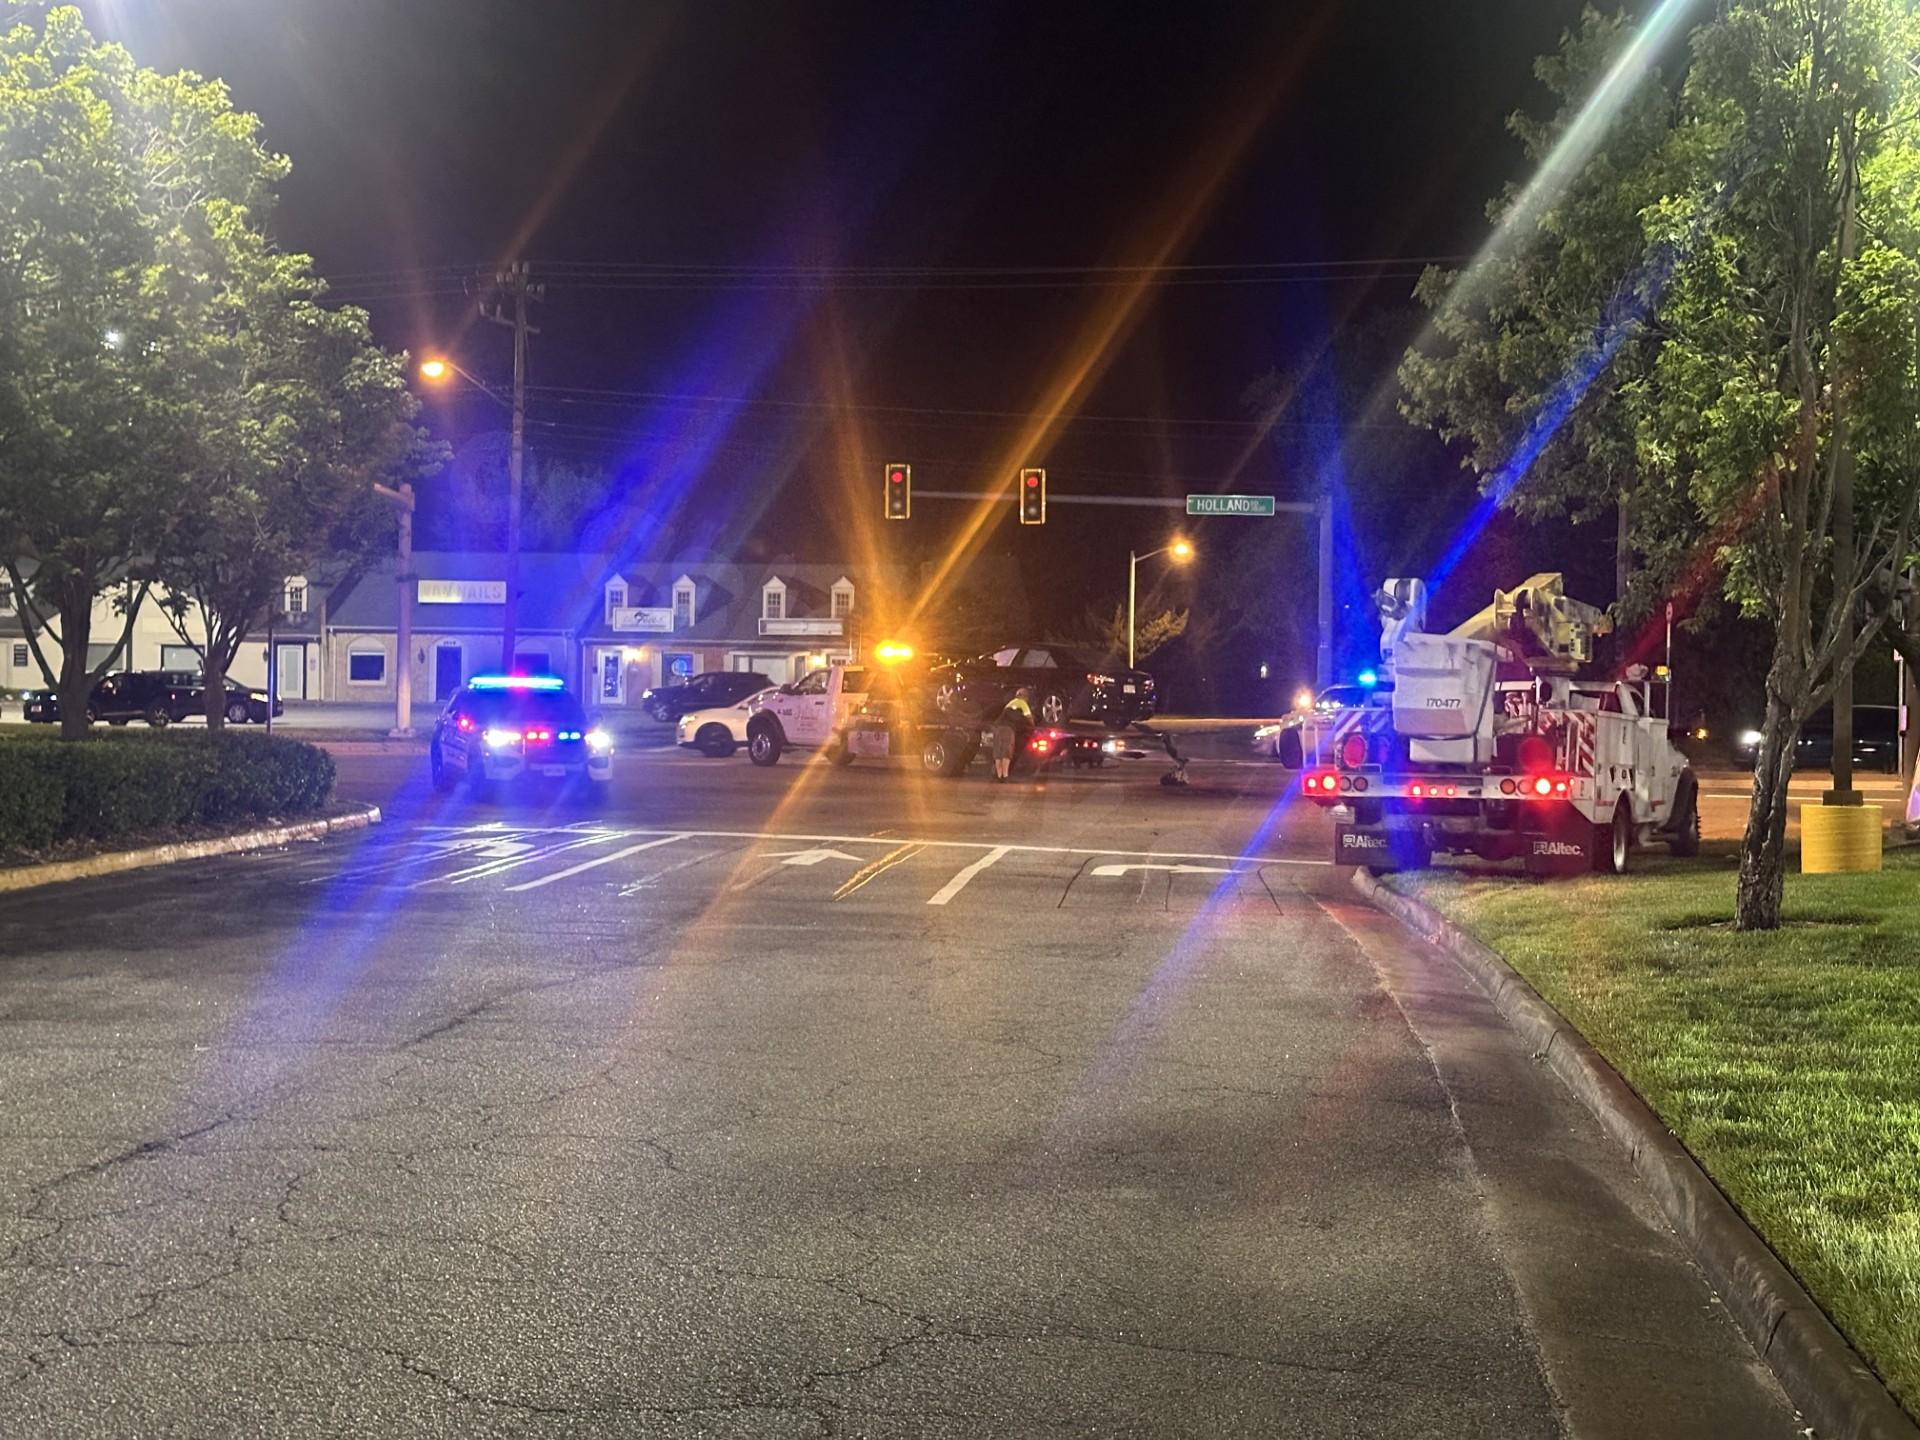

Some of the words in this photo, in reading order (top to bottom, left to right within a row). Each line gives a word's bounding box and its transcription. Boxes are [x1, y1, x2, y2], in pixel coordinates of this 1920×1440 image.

[1197, 499, 1250, 511] HOLLAND
[457, 585, 502, 599] NAILS
[1548, 842, 1581, 855] Altec
